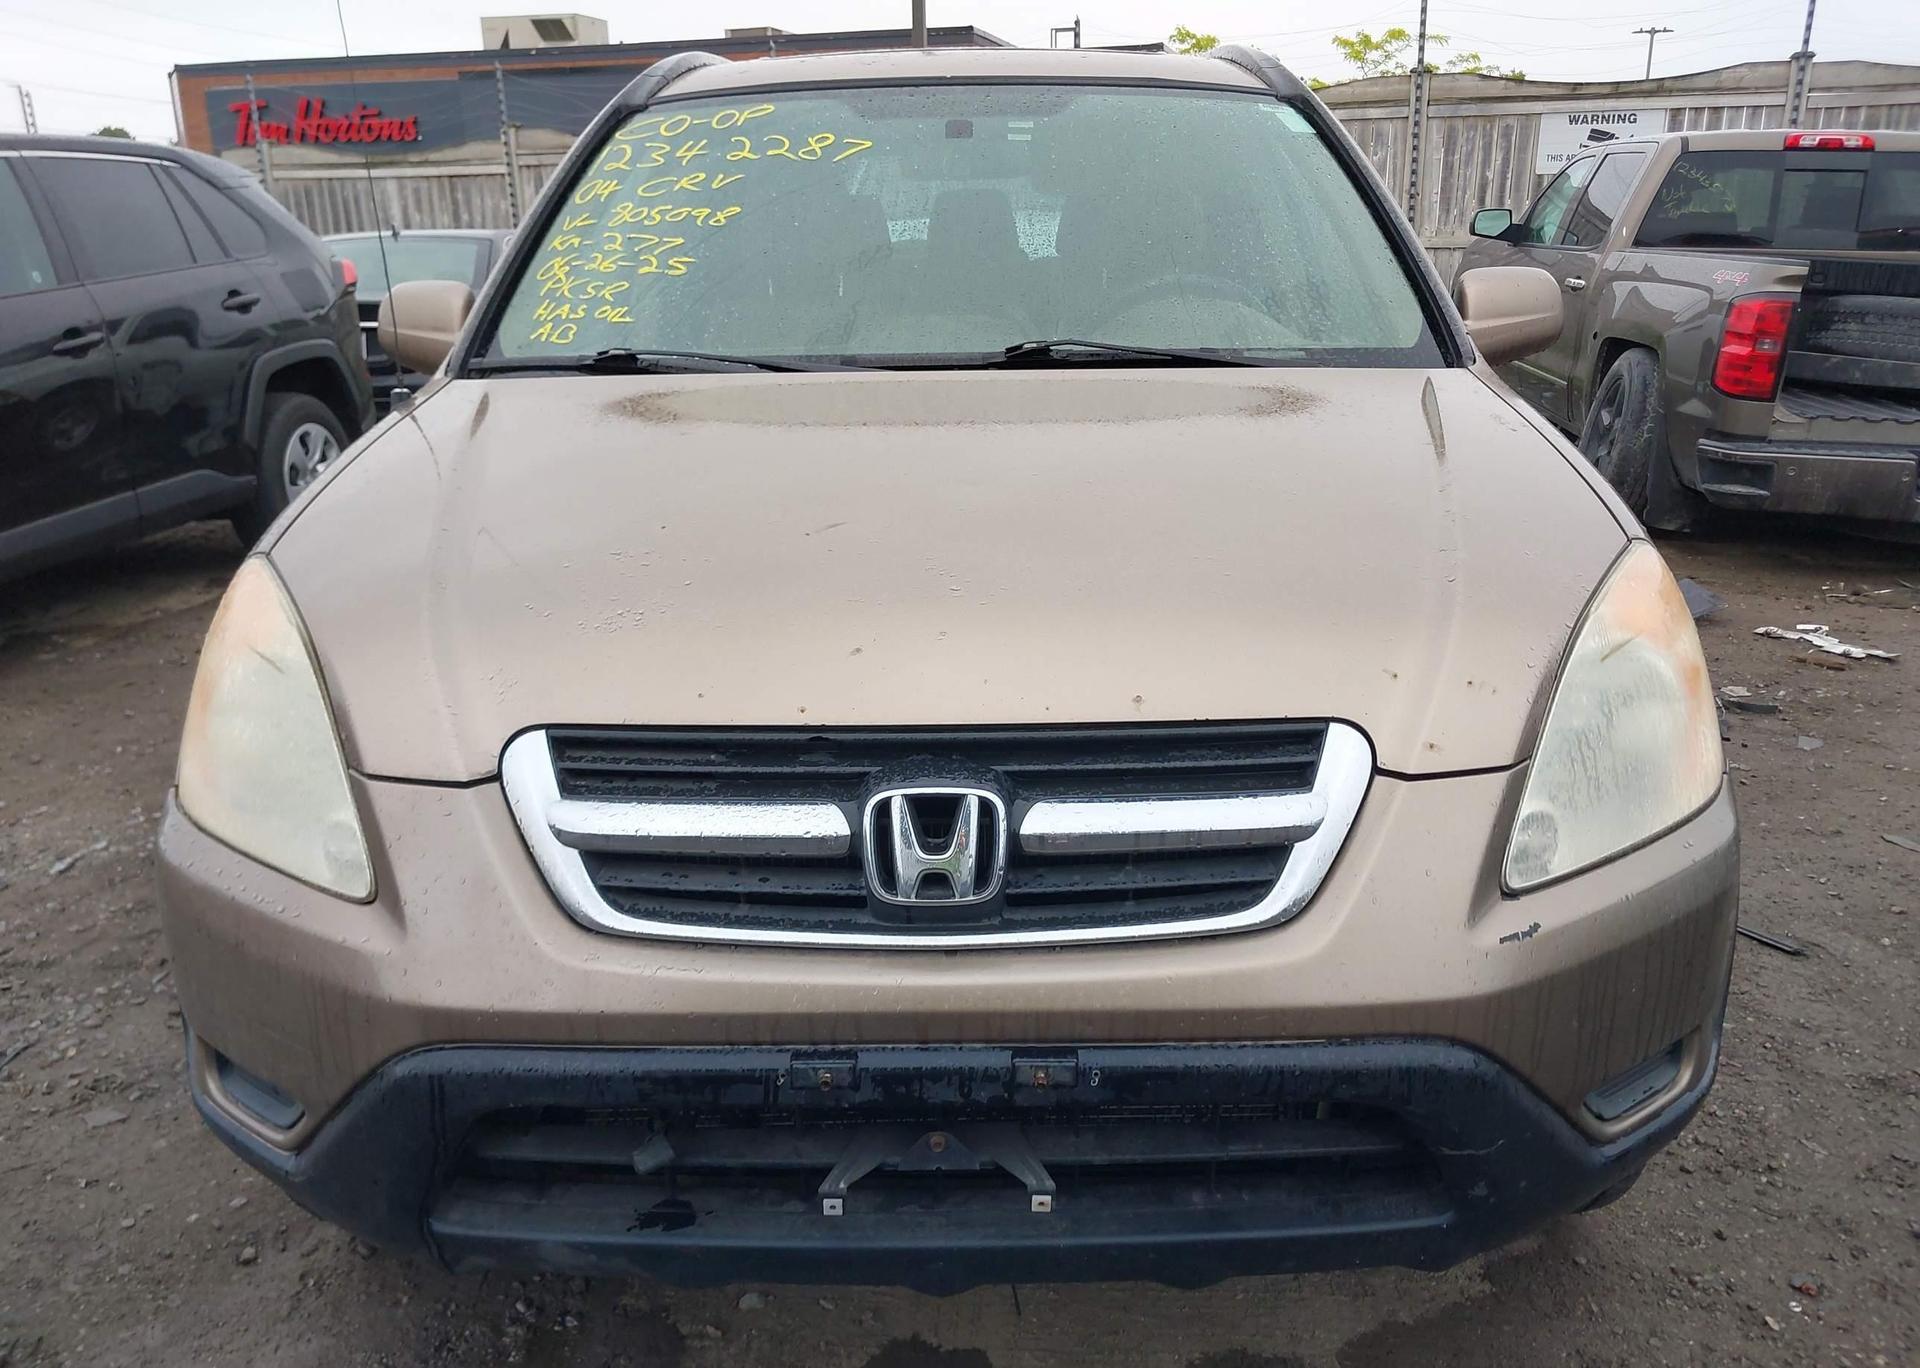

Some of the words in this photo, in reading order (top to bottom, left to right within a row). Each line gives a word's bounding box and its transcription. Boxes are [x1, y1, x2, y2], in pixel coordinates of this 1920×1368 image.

[228, 99, 288, 146] Tim
[294, 96, 417, 144] Hortons
[614, 104, 775, 139] CO-OP
[1568, 112, 1638, 126] WARNING
[1546, 153, 1563, 163] THIS
[602, 232, 685, 255] 277
